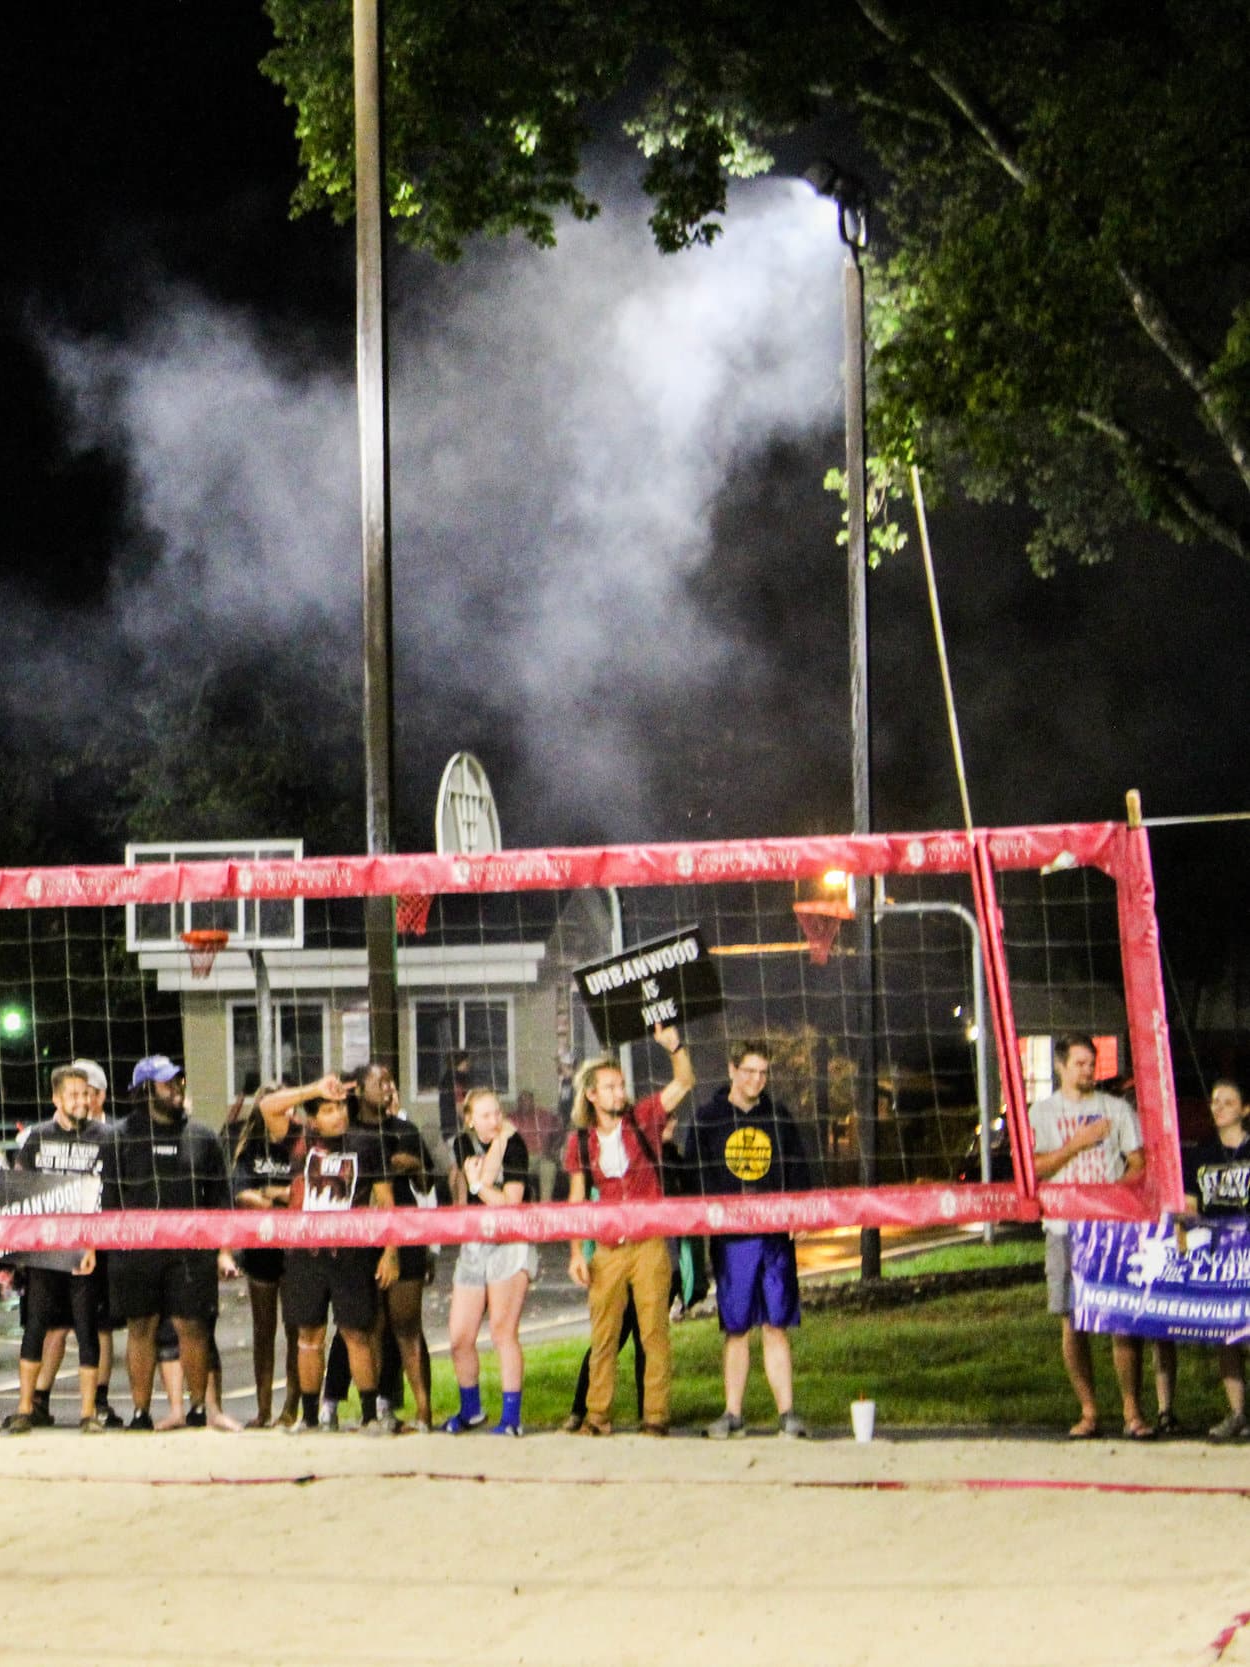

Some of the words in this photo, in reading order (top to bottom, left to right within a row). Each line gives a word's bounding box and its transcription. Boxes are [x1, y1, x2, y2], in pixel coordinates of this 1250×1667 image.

[585, 938, 699, 995] URBANWOOD
[642, 978, 660, 1000] IS
[641, 998, 678, 1026] HERE
[1084, 1289, 1141, 1310] NORTH
[1145, 1298, 1241, 1319] GREENVILLE
